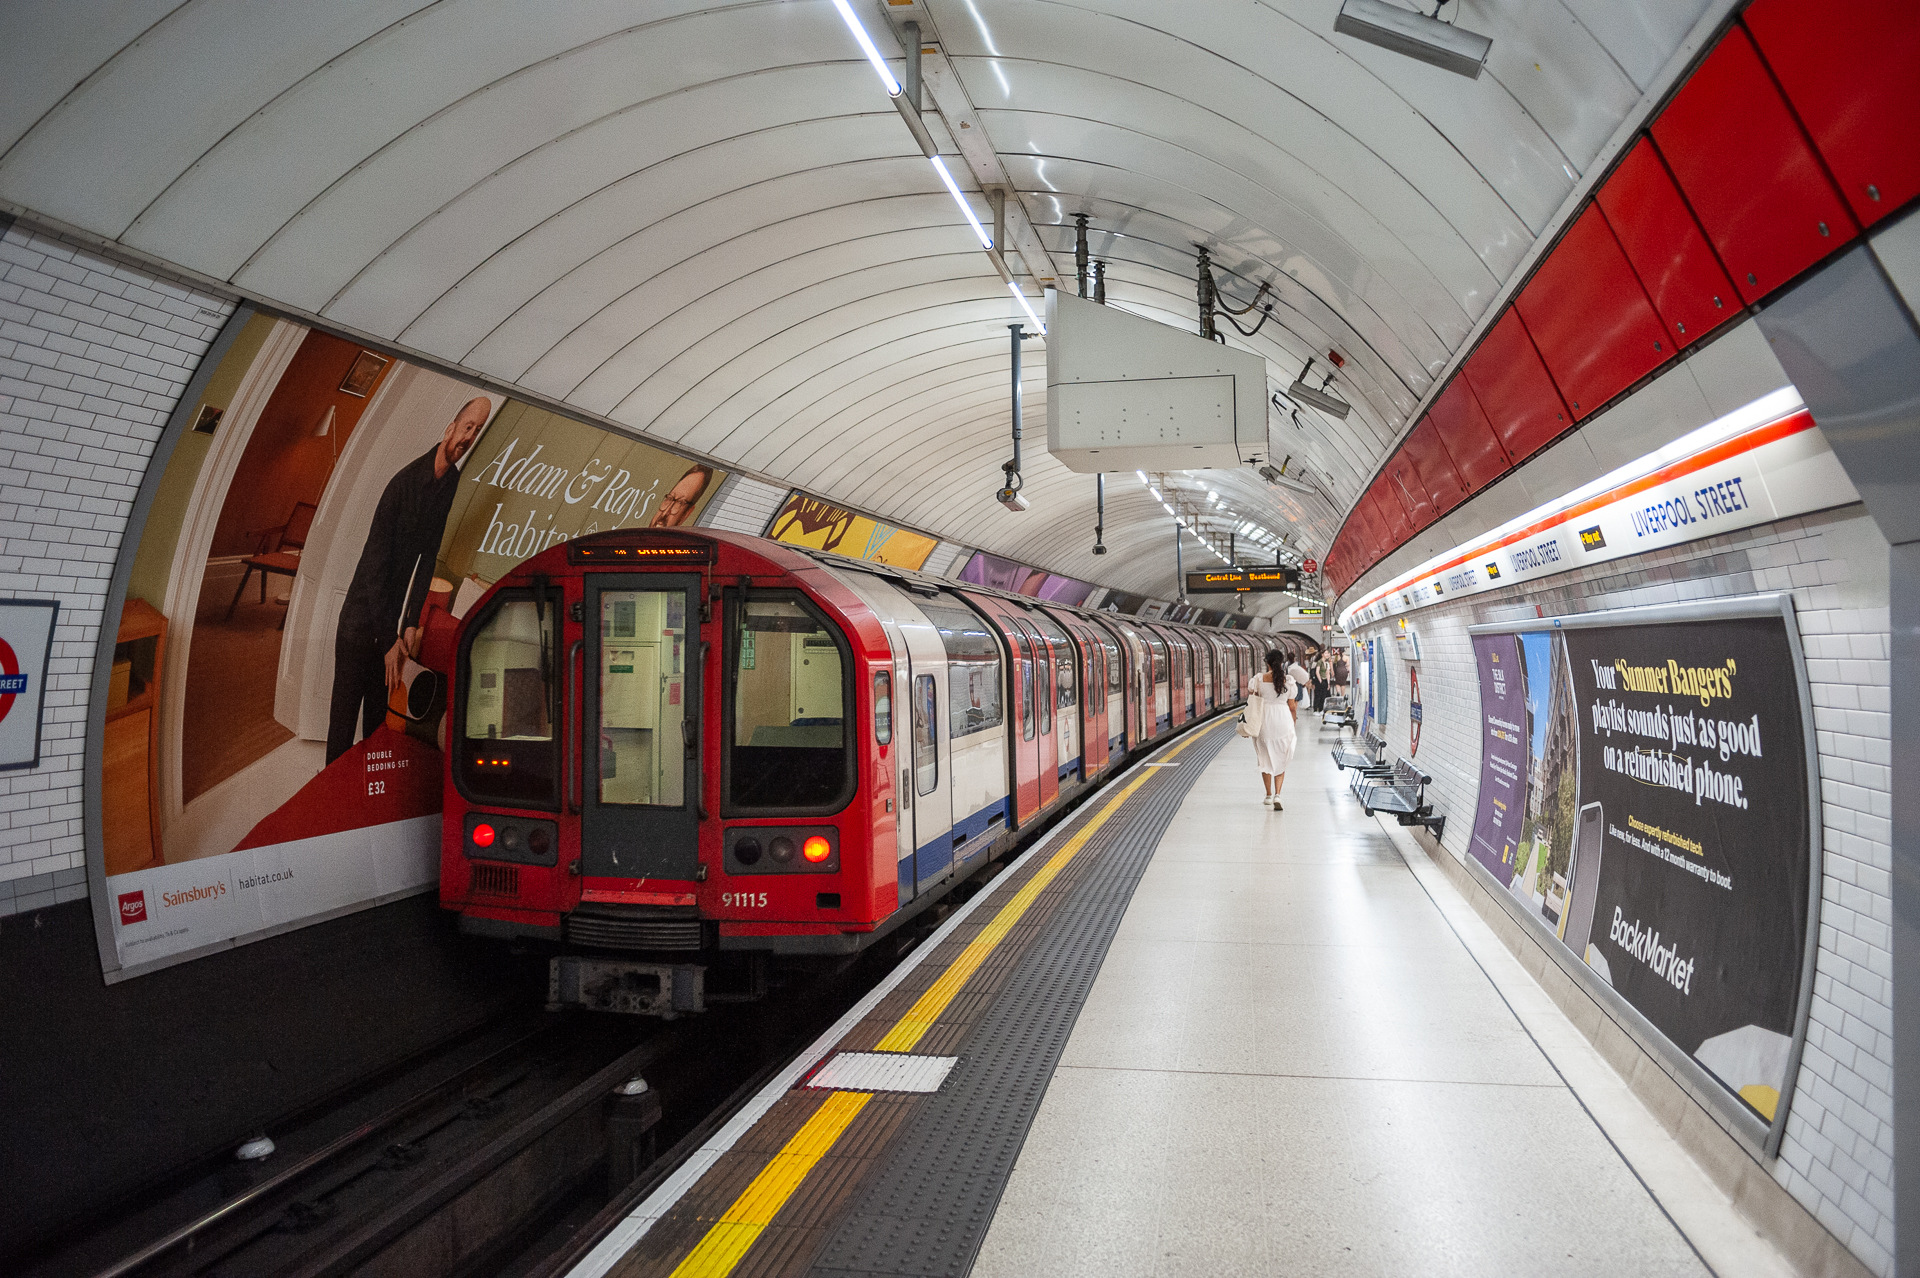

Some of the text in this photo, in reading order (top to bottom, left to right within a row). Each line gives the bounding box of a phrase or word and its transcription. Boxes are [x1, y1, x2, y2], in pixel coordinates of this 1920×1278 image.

[472, 437, 659, 530] Adam & Ray's
[1630, 477, 1749, 538] LIVERPOOL STREET
[477, 503, 580, 558] habit
[1510, 540, 1561, 572] LIVERPOOL STREET
[1205, 573, 1228, 582] Central
[1591, 659, 1616, 690] Your
[1592, 698, 1763, 762] playlist sounds just as good
[367, 750, 392, 760] DOUBLE
[367, 759, 409, 772] BEDDING SET
[368, 780, 386, 796] £32
[1603, 745, 1749, 810] on a refurbished phone.
[1628, 814, 1704, 856] Choose expertly refurbished tech.
[1609, 823, 1617, 836] Like
[1631, 833, 1642, 849] less.
[1641, 837, 1651, 853] And
[1650, 843, 1661, 859] with
[1664, 847, 1670, 862] 12
[1669, 853, 1686, 869] month
[1685, 860, 1710, 883] warranty
[1709, 868, 1717, 883] to
[1716, 870, 1733, 891] boot.
[238, 867, 294, 890] habitat.co.uk
[122, 900, 143, 912] Argos
[162, 881, 226, 908] Sainsbury's
[722, 892, 768, 907] 91115
[1610, 905, 1695, 996] Back Market
